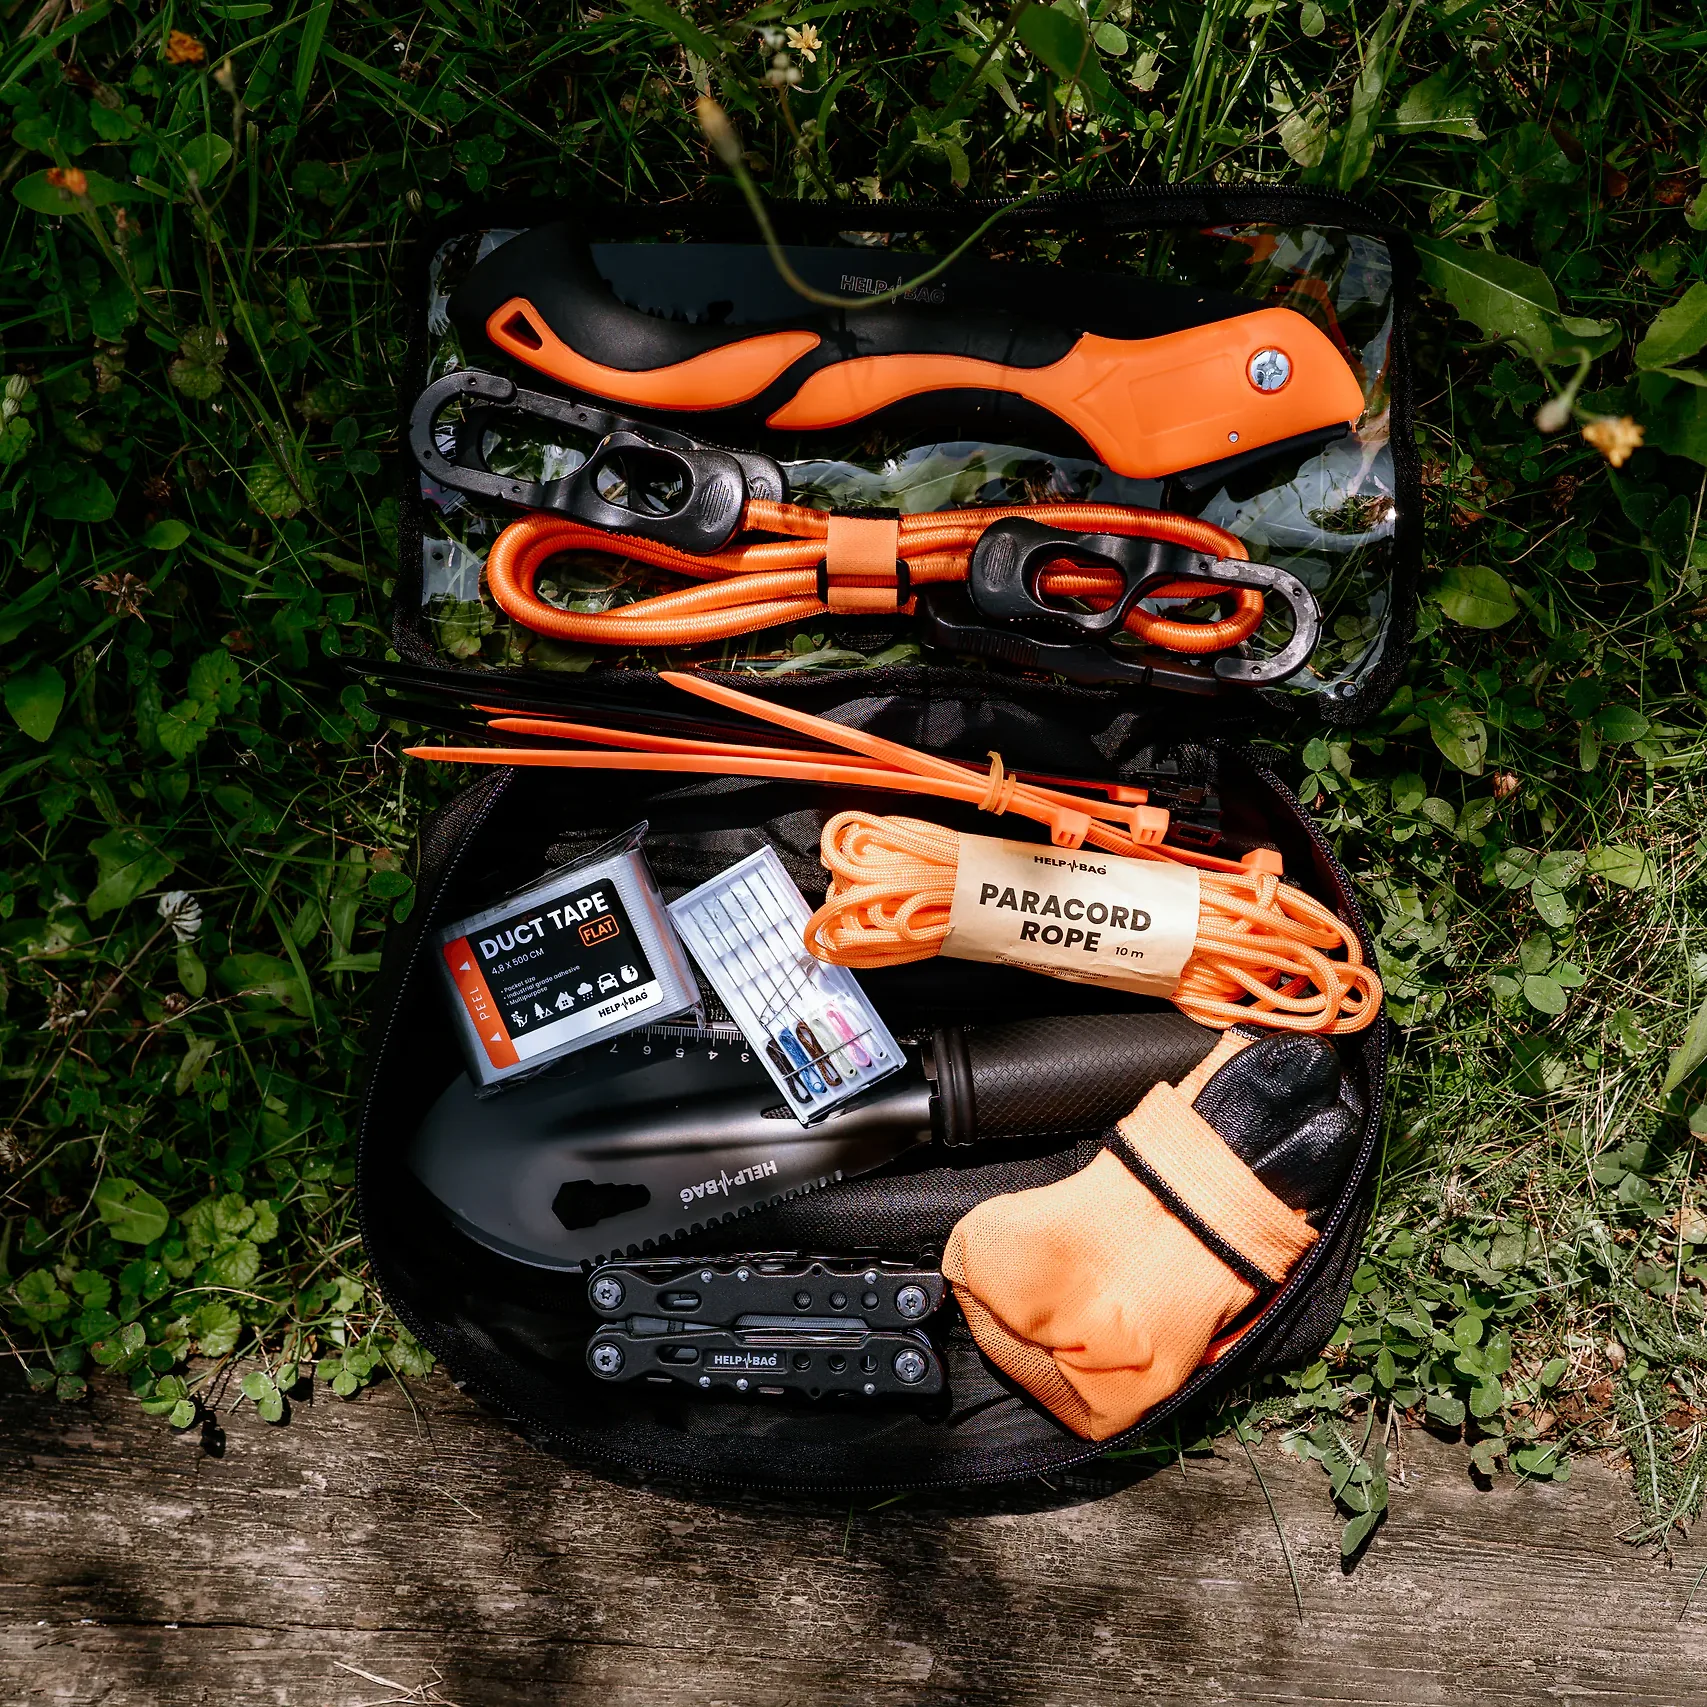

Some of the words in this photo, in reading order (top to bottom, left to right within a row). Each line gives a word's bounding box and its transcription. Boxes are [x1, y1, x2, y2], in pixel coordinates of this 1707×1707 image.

[840, 274, 888, 296] HELP
[1034, 855, 1067, 868] HELP
[1079, 863, 1107, 875] BAG
[979, 882, 1152, 932] PARACORD
[479, 917, 545, 960] DUCT
[547, 891, 609, 931] TAPE
[583, 920, 613, 941] FLAT
[1019, 920, 1102, 953] ROPE
[491, 964, 505, 976] 4,8
[512, 954, 529, 966] 500
[529, 947, 545, 959] CM
[1115, 946, 1129, 957] 10
[1130, 950, 1144, 959] m
[503, 981, 524, 993] Pocket
[524, 976, 536, 985] size
[507, 984, 535, 999] Industrial
[535, 976, 554, 989] grade
[553, 964, 581, 980] adhesive
[469, 986, 490, 1021] PEEL
[509, 986, 548, 1006] Multipurpose
[598, 1003, 622, 1018] HELP
[628, 990, 649, 1006] BAG
[610, 1043, 619, 1053] 7
[643, 1045, 651, 1055] 6
[675, 1048, 685, 1059] 5
[708, 1050, 719, 1061] 4
[740, 1052, 750, 1063] 3
[734, 1160, 778, 1186] HELP
[679, 1179, 719, 1203] BAG
[714, 1355, 742, 1365] HELP
[752, 1355, 777, 1366] BAG
